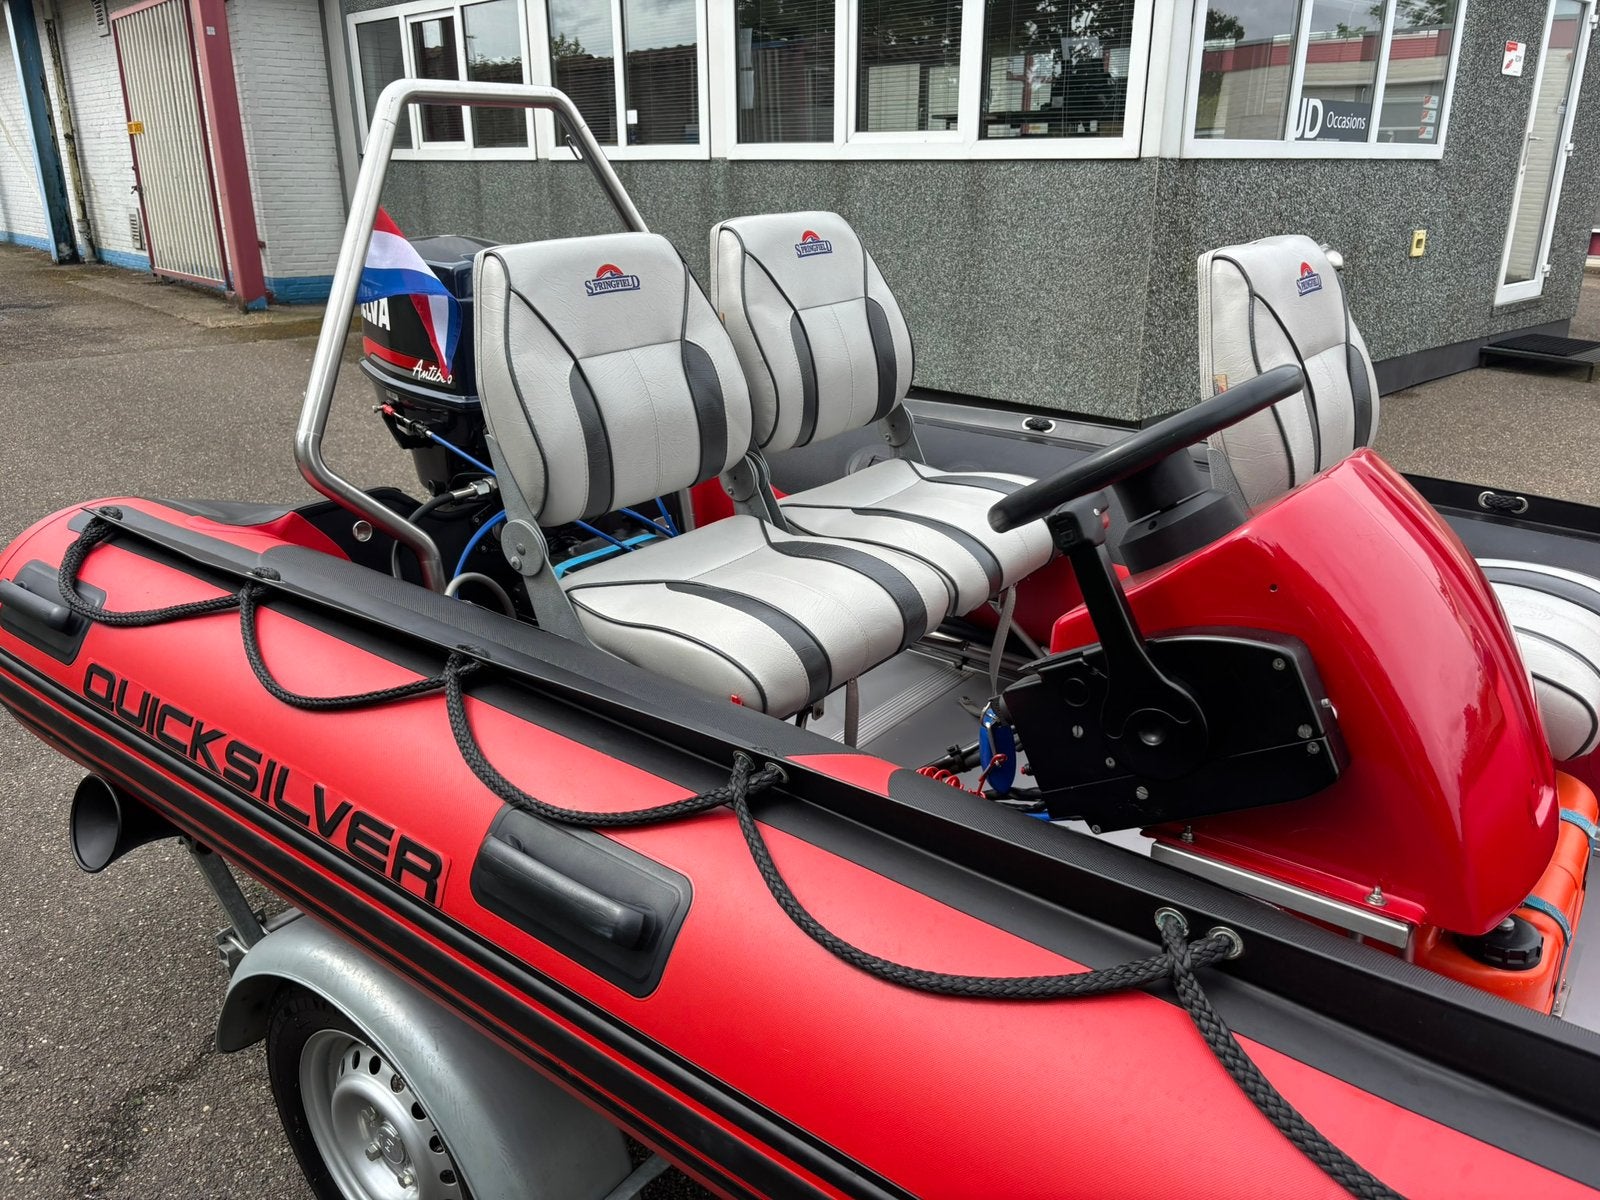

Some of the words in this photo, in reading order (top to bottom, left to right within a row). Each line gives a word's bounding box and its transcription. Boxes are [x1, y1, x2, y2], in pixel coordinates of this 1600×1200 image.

[1327, 111, 1366, 129] Occasions
[585, 275, 640, 296] SPRINGFIELD
[83, 662, 443, 905] QUICKSILVER
